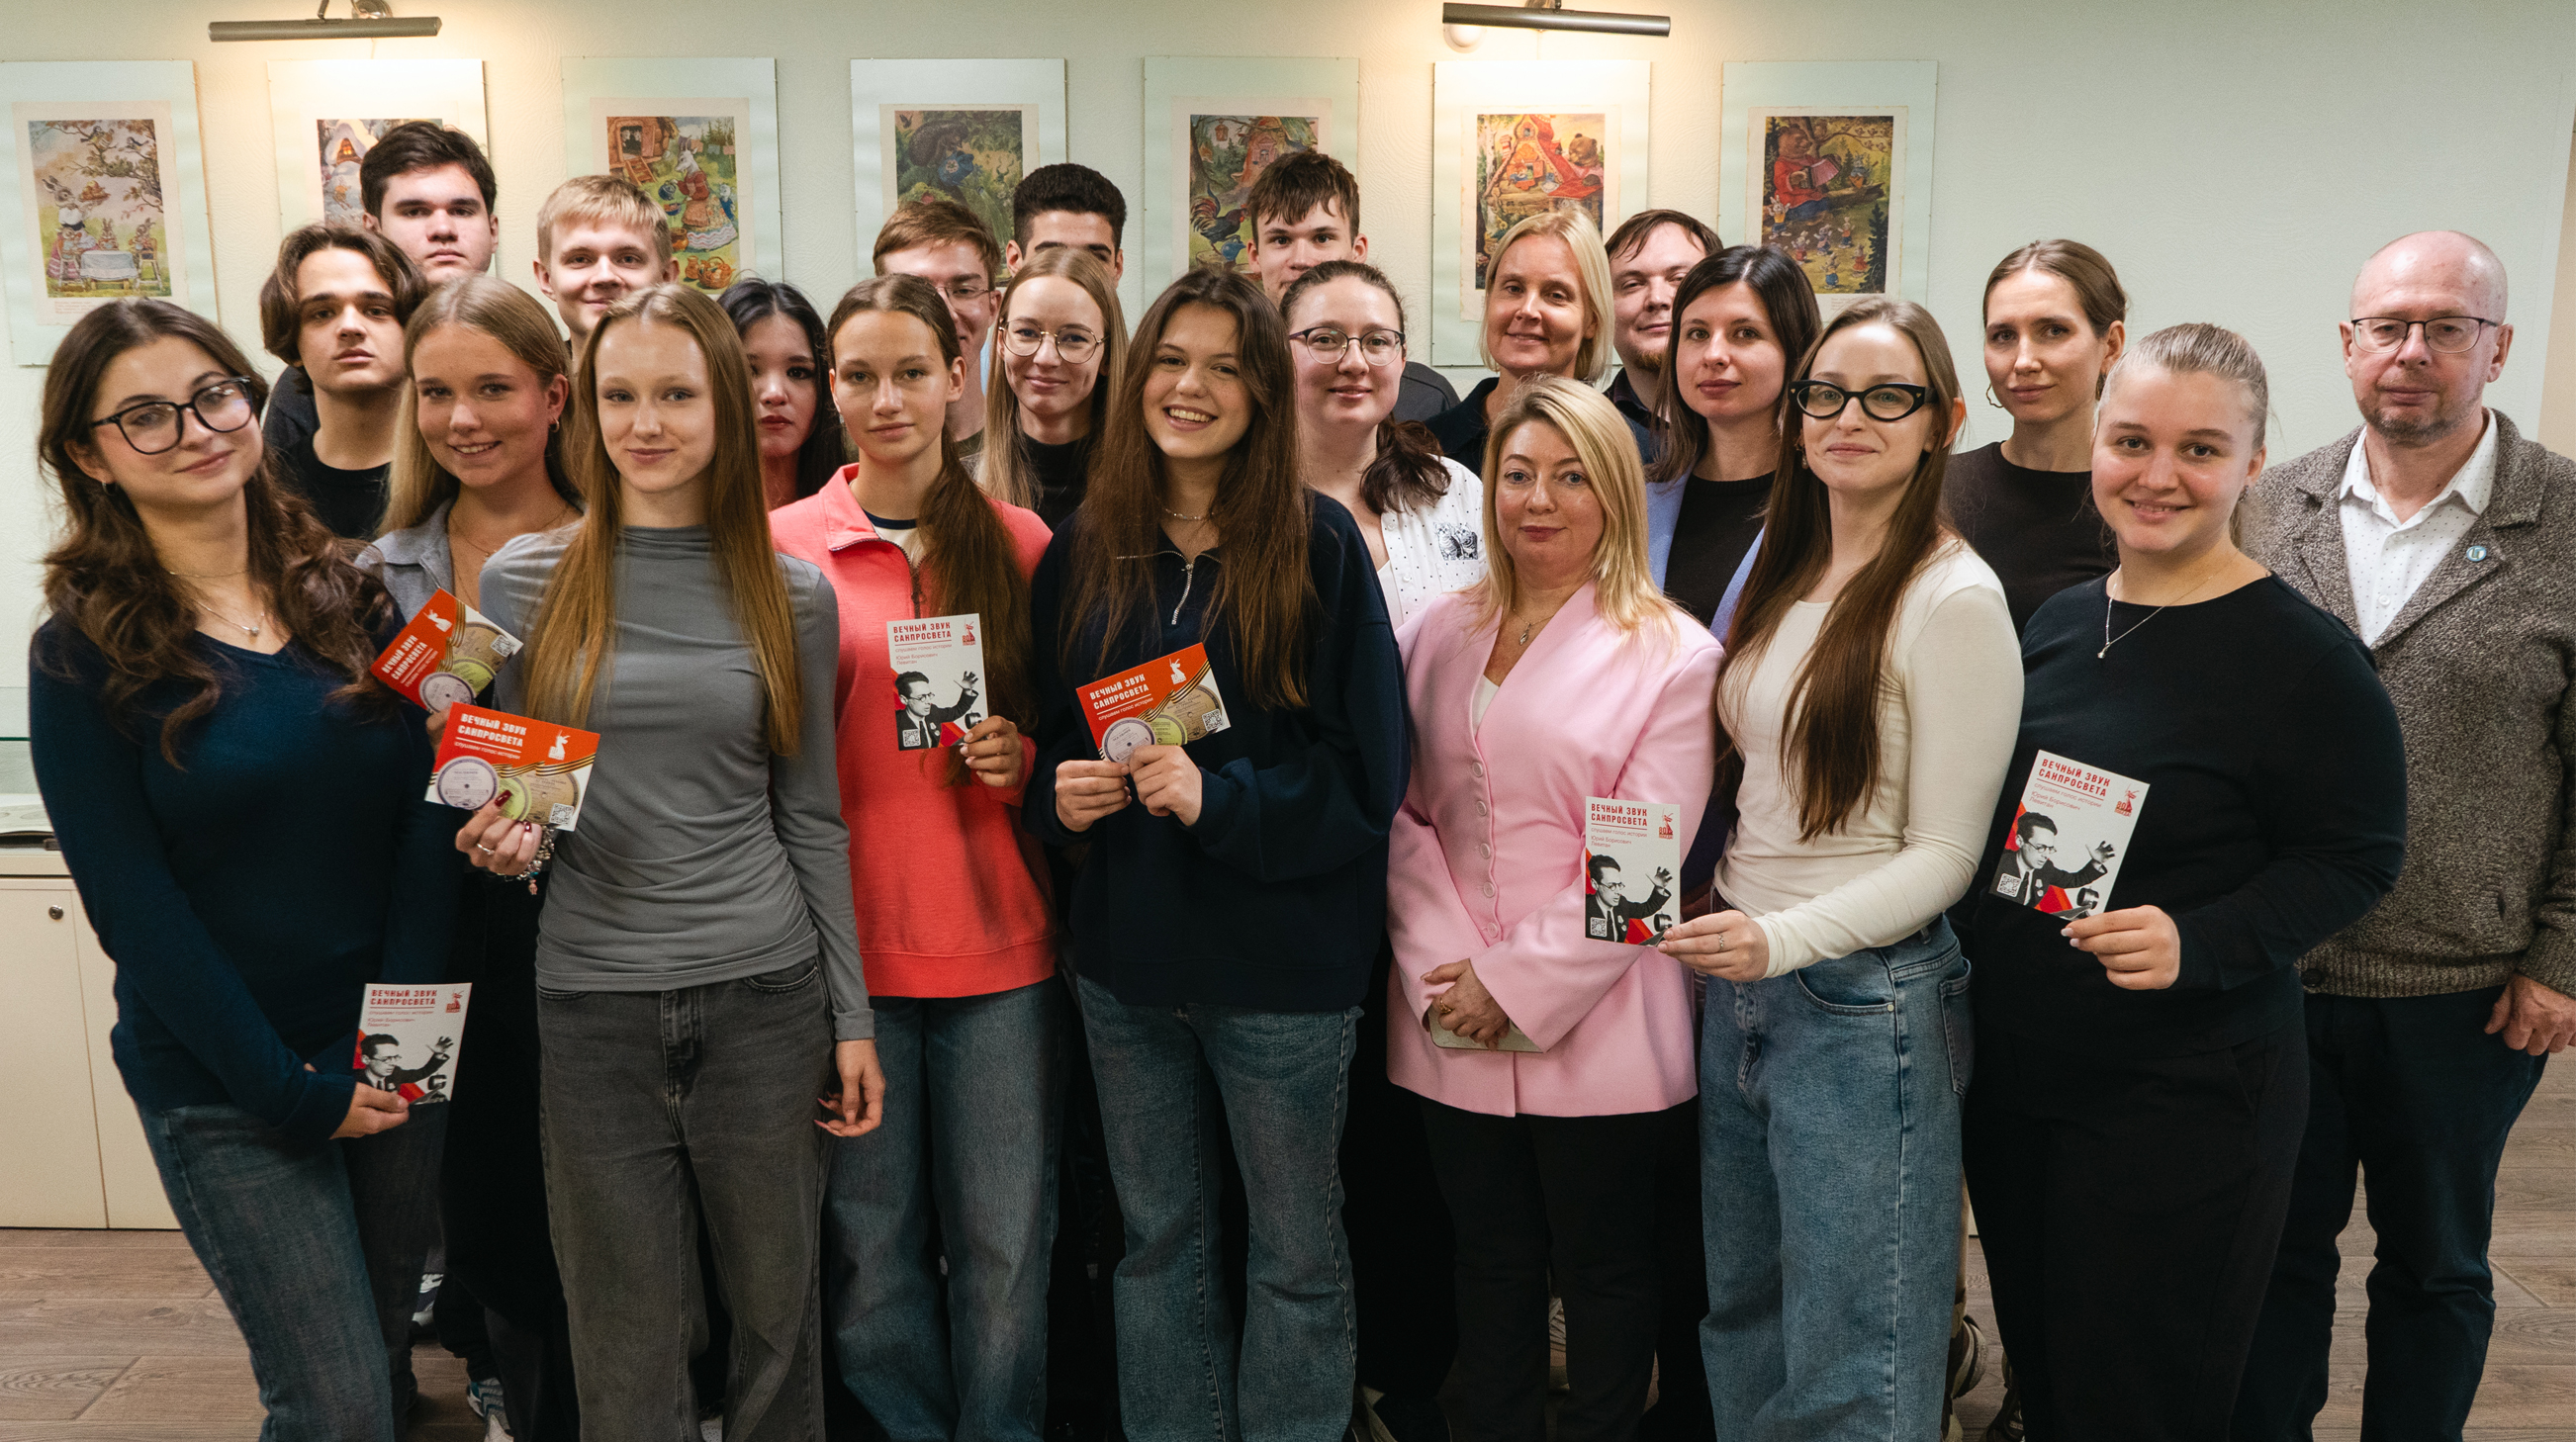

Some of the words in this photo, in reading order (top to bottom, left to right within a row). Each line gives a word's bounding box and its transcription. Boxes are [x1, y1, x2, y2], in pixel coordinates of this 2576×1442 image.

[893, 623, 926, 633] ВЕЧНЫЙ
[930, 621, 950, 630] ЗВУК
[894, 631, 952, 642] САНПРОСВЕТА
[381, 649, 405, 674] ВЕЧНЫЙ
[401, 635, 418, 651] ЗВУК
[391, 642, 427, 680] САНПРОСВЕТА
[1090, 680, 1123, 700] ВЕЧНЫЙ
[1124, 674, 1146, 687] ЗВУК
[1093, 684, 1150, 710] САНПРОСВЕТА
[1098, 710, 1120, 721] слушаем
[1120, 704, 1136, 714] голос
[461, 713, 501, 730] ВЕЧНЫЙ
[502, 722, 526, 736] ЗВУК
[457, 726, 522, 747] САНПРОСВЕТА
[2038, 768, 2107, 797] САНПРОСВЕТА
[2042, 759, 2081, 777] ВЕЧНЫЙ
[2085, 772, 2111, 787] ЗВУК
[2032, 791, 2048, 801] Юрий
[2049, 795, 2080, 810] Борисович
[2061, 790, 2077, 801] голос
[2077, 796, 2101, 807] истории
[1591, 803, 1622, 814] ВЕЧНЫЙ
[1626, 807, 1647, 817] ЗВУК
[1591, 813, 1647, 826] САНПРОСВЕТА
